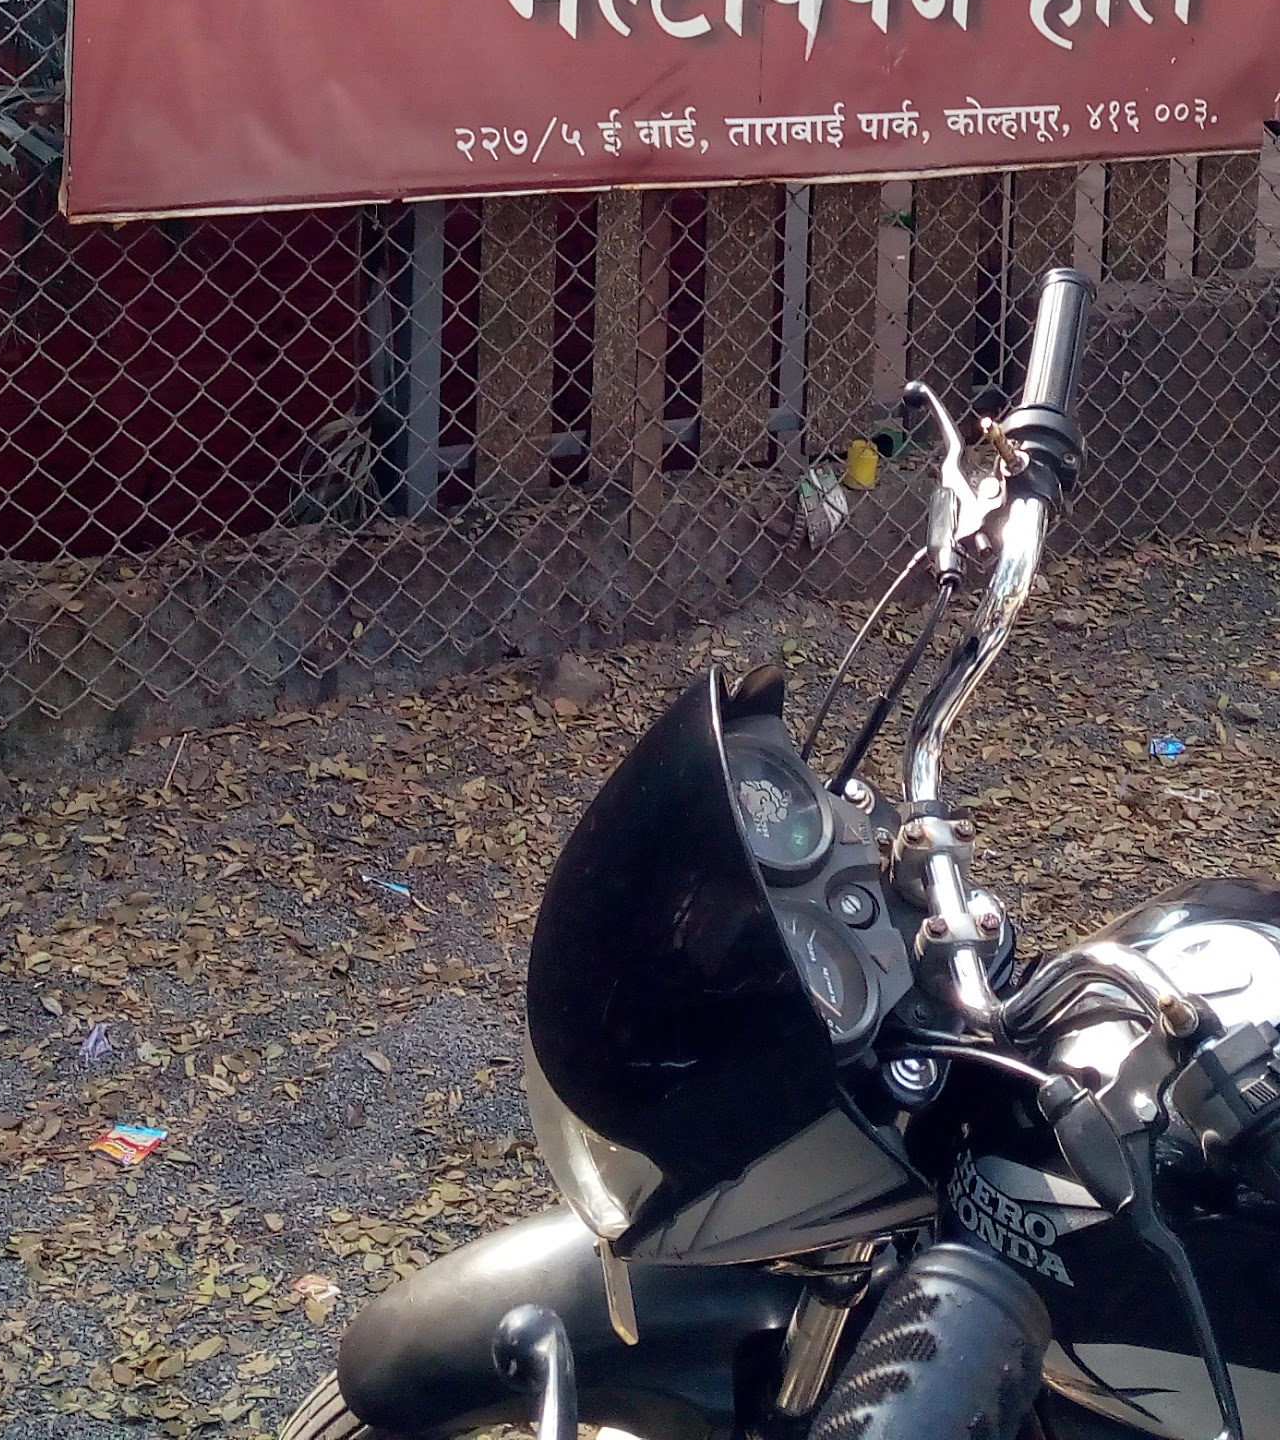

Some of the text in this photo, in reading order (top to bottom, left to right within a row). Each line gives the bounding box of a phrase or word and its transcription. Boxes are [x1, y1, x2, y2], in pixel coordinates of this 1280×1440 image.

[454, 116, 585, 163] २२७/५
[597, 108, 623, 157] ई
[724, 102, 846, 148] ताराबाई
[856, 99, 930, 145] पार्क,
[943, 96, 1070, 143] कोल्हापूर,
[1086, 100, 1140, 133] ४१६
[946, 1166, 1075, 1288] HONDA
